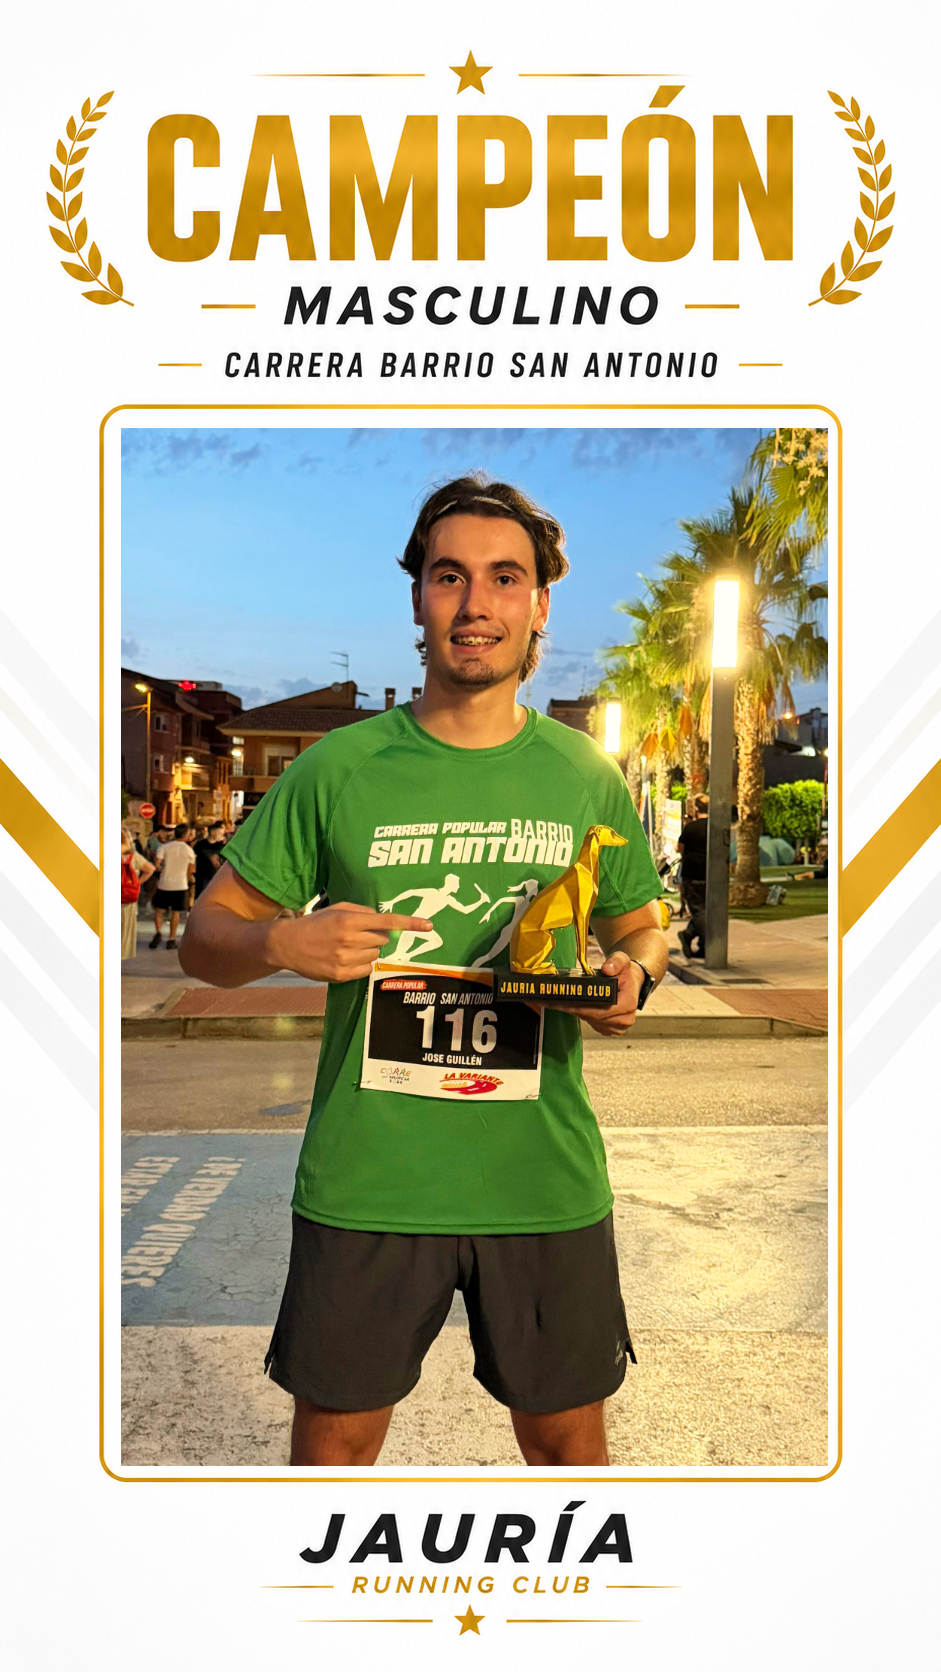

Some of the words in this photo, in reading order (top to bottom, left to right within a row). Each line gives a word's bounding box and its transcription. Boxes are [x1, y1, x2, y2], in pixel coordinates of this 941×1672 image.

[373, 822, 439, 839] CARRERA
[441, 821, 508, 835] POPULAR
[510, 818, 574, 844] BARRIO
[367, 838, 434, 868] SAN
[440, 836, 574, 868] ANTONIO
[382, 981, 403, 989] CARRERA
[403, 981, 424, 990] POPULAR
[500, 981, 535, 994] JAURIA
[539, 983, 583, 996] RUNNING
[587, 984, 611, 997] CLUB
[403, 991, 436, 1005] BARRIO
[440, 992, 458, 1005] SAN
[458, 992, 494, 1006] ANTONIO
[416, 1005, 498, 1054] 116
[422, 1052, 444, 1064] JOSE
[446, 1054, 483, 1066] GUILLÉN
[444, 1072, 456, 1080] LA
[459, 1072, 504, 1086] VARIANTE
[159, 1177, 234, 1221] VERDAD
